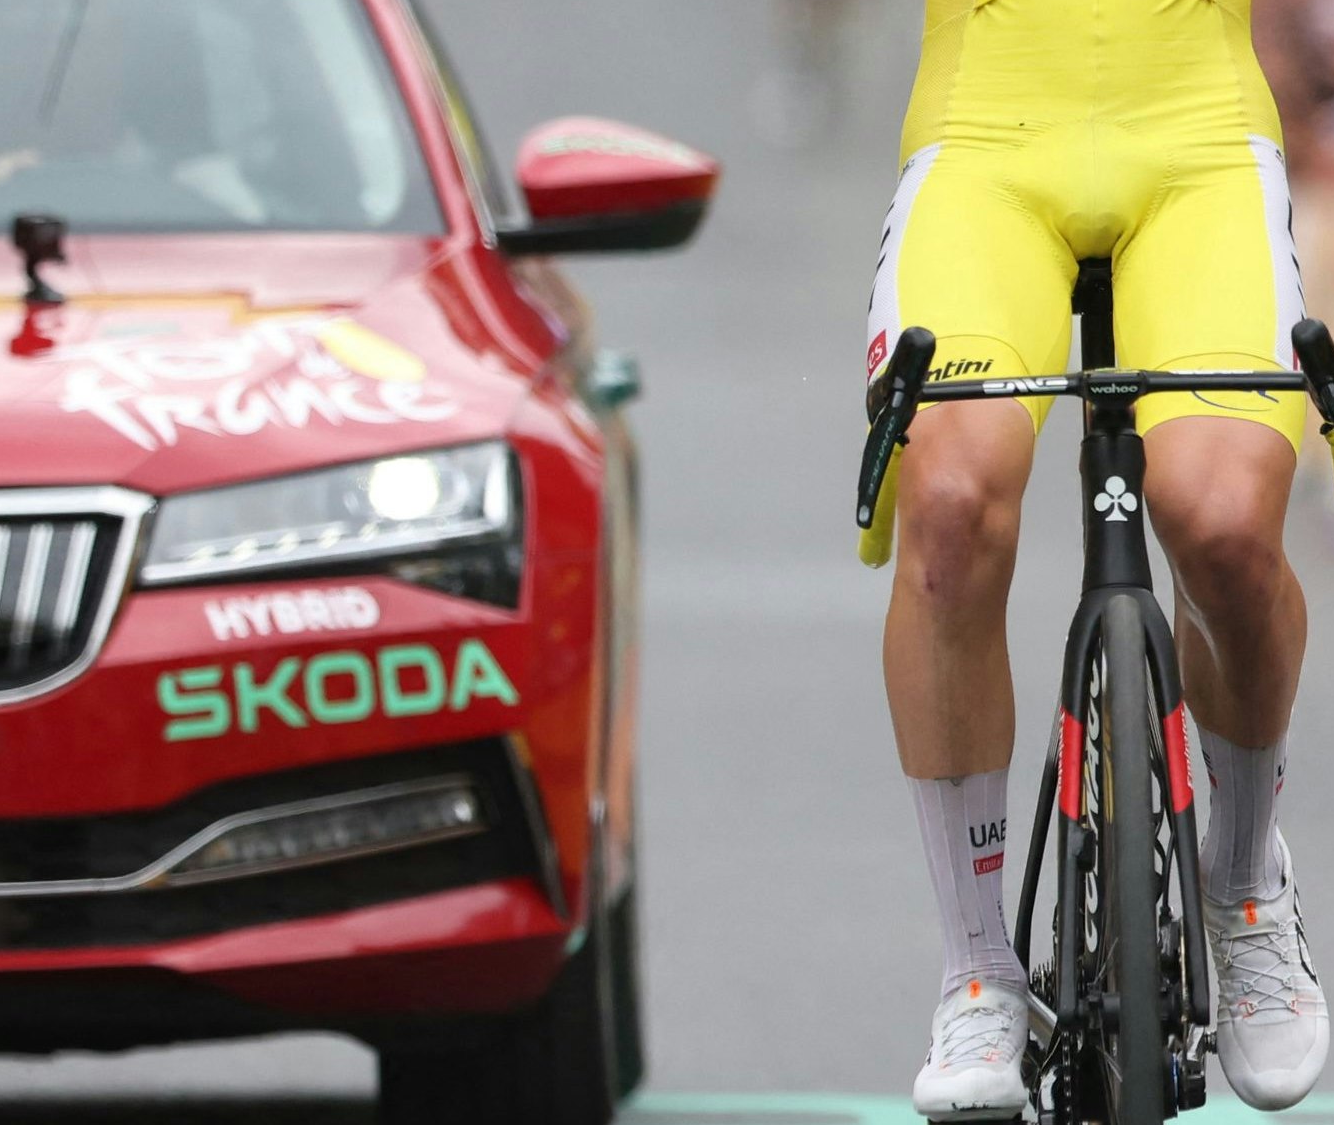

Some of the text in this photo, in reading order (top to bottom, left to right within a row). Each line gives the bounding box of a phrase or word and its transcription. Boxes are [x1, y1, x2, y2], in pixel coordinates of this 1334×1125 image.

[925, 359, 994, 383] ntini
[1089, 385, 1139, 395] wahoo
[203, 586, 381, 641] HYBRID
